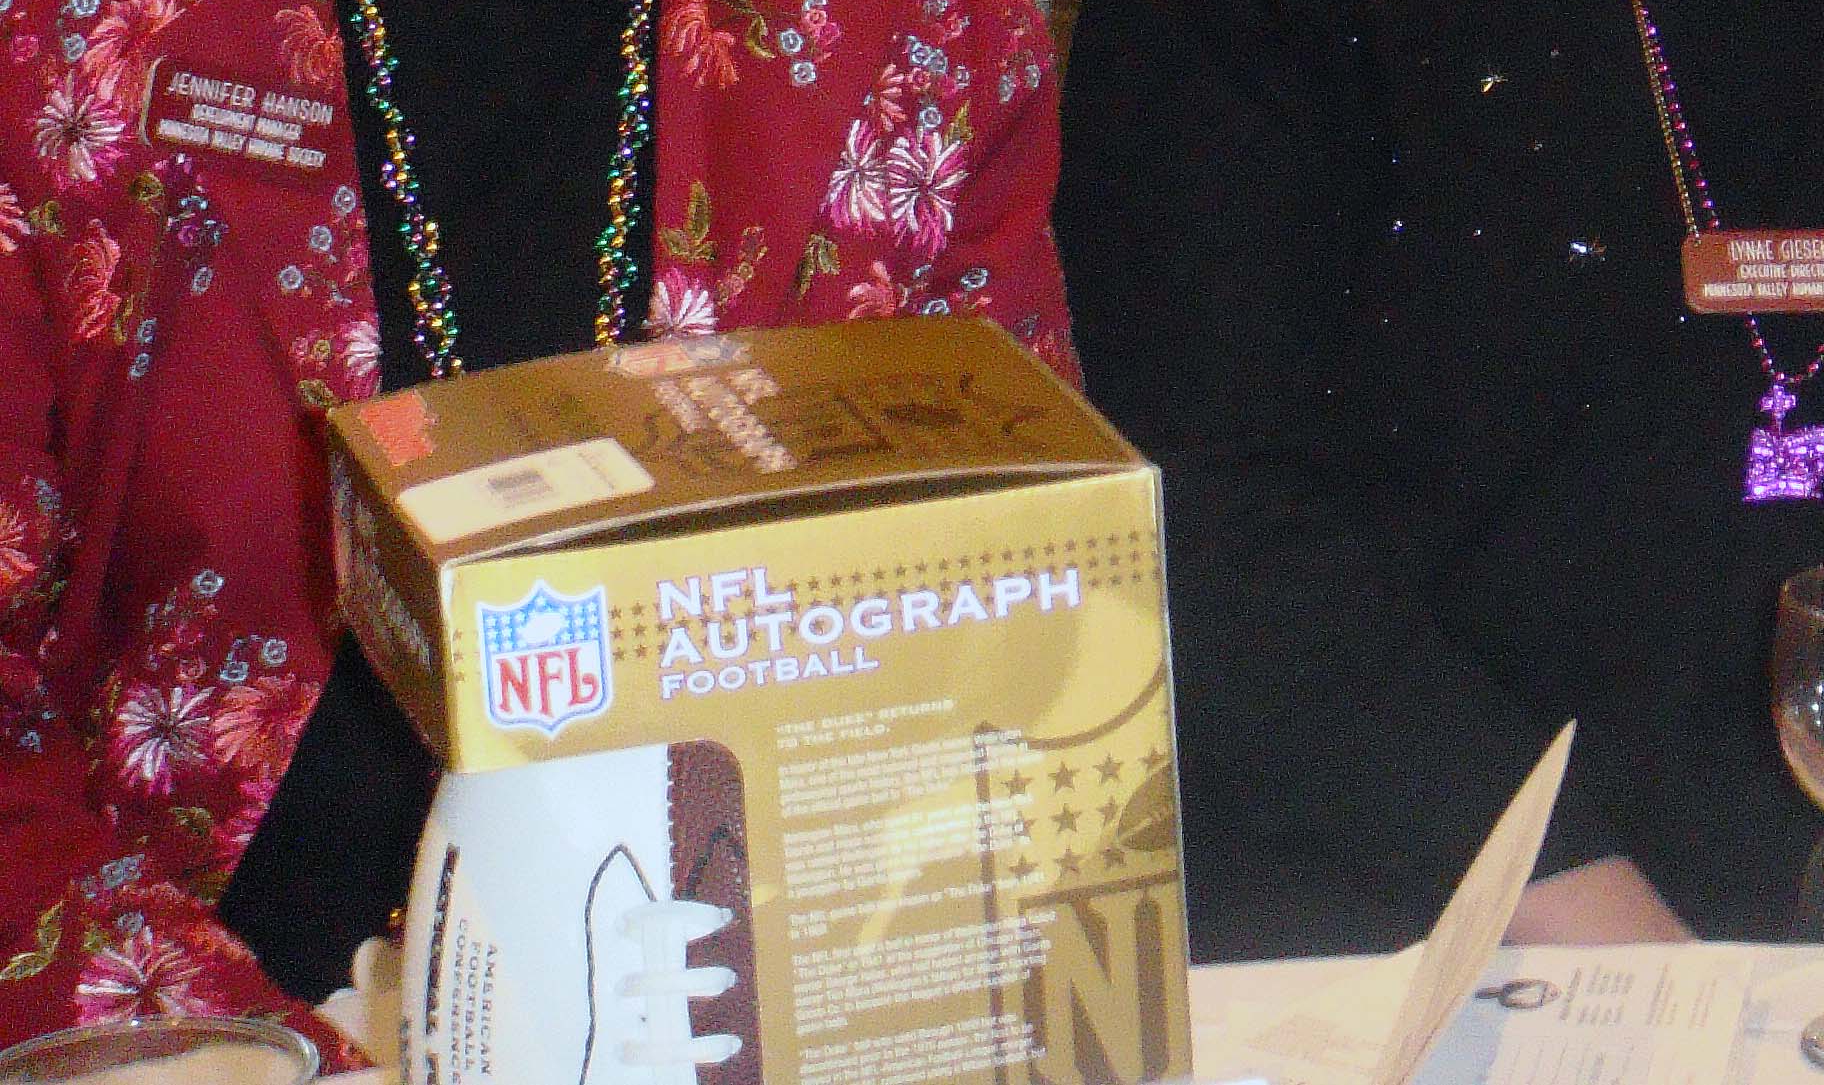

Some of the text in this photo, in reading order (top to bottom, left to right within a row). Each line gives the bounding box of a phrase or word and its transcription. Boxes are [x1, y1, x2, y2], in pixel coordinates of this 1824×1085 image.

[168, 72, 333, 124] JENNIFER HANSON
[1730, 239, 1774, 261] LYNAE
[1740, 264, 1787, 278] EXECUTIVE
[1704, 282, 1752, 297] MINNESOTA
[1757, 282, 1788, 297] VALLEY
[658, 566, 796, 617] NFL
[659, 568, 1083, 668] AUTOGRAPH
[494, 647, 599, 717] NFL
[661, 646, 880, 700] FOOTBALL
[464, 940, 482, 1072] FOOTBALL
[480, 942, 500, 1076] AMERICAN
